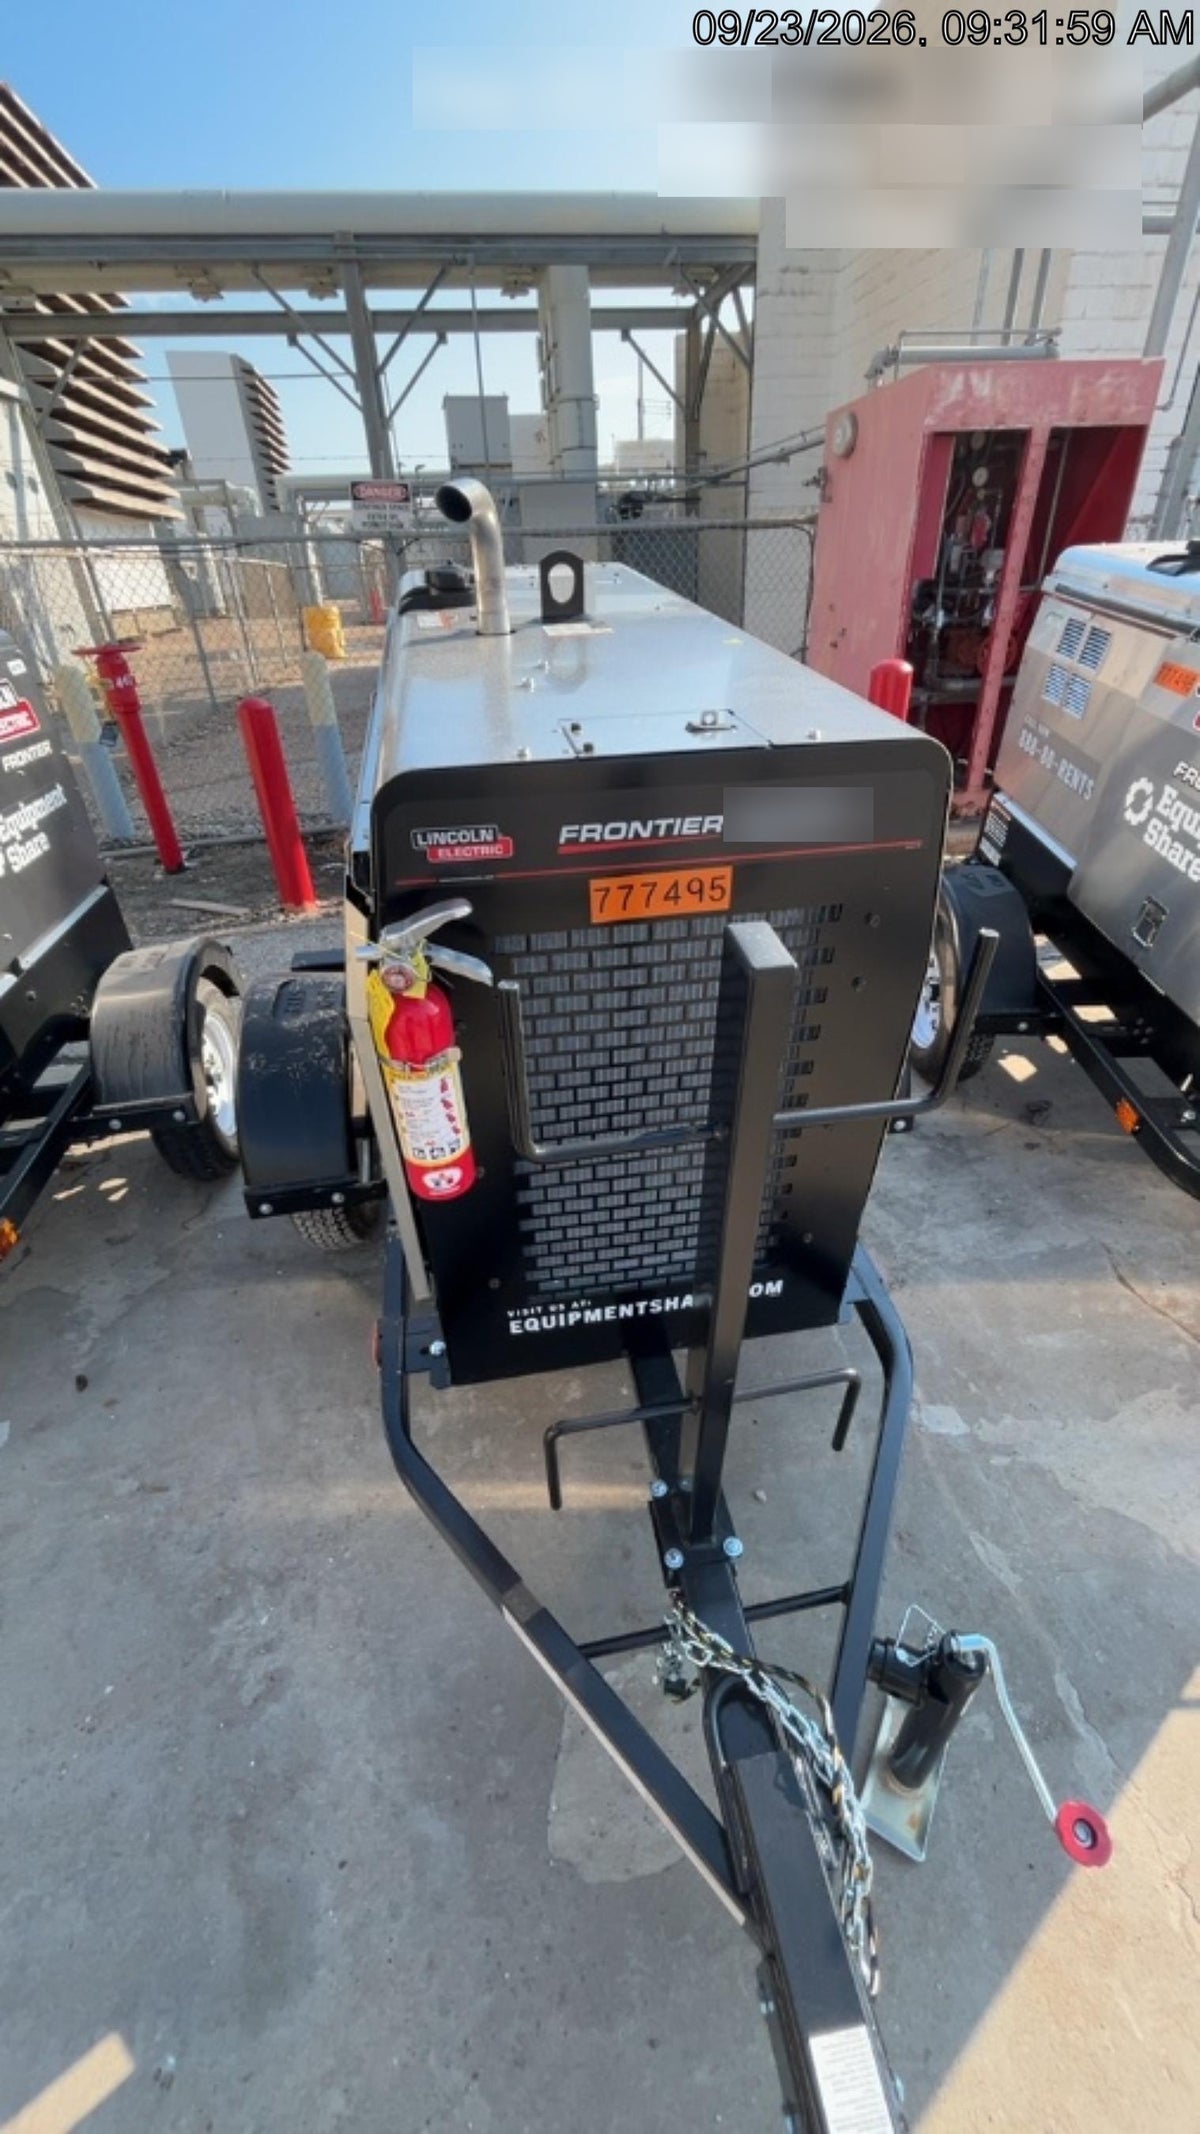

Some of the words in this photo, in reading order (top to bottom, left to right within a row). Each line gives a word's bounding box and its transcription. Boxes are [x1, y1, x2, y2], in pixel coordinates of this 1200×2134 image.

[2, 739, 53, 773] FRONTIER
[416, 829, 495, 846] LINCOLN
[559, 814, 724, 845] FRONTIER
[437, 844, 504, 858] ELECTRIC
[1143, 816, 1200, 883] Share
[593, 875, 727, 914] 777495
